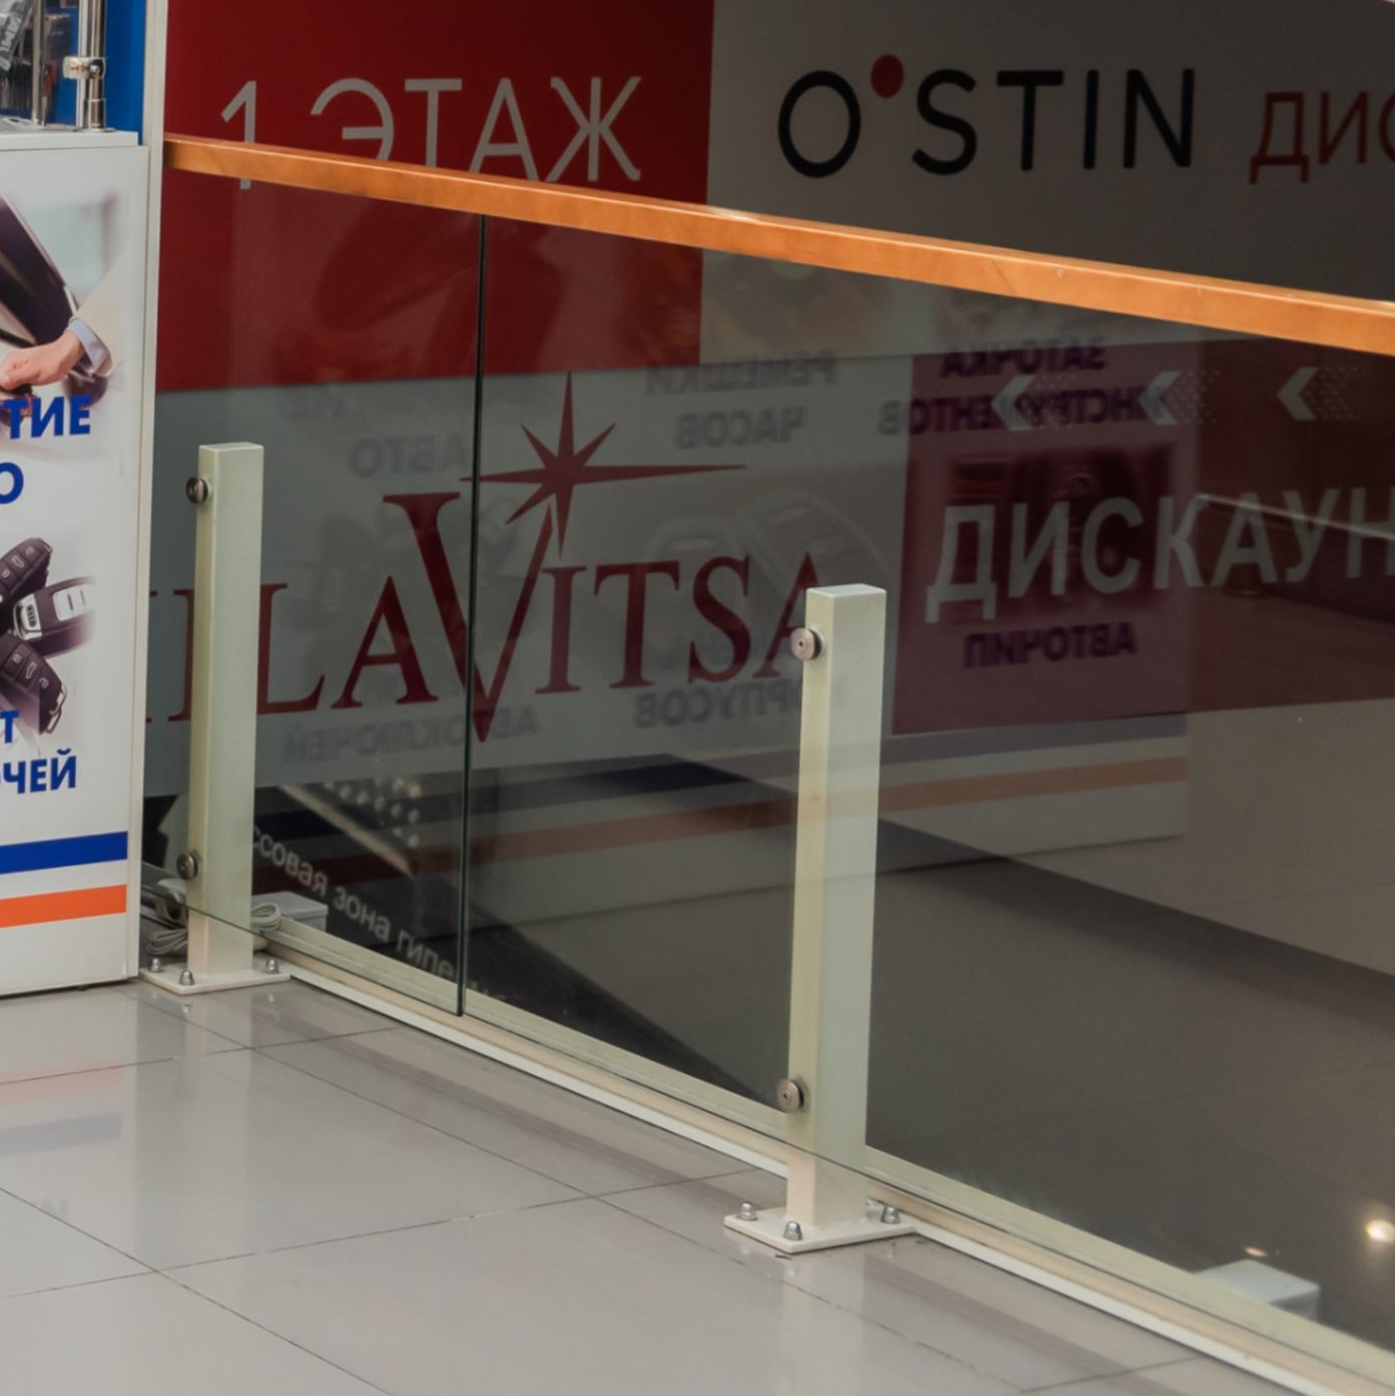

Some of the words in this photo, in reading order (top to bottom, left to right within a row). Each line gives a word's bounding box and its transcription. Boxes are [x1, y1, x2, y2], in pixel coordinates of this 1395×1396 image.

[221, 80, 257, 190] 1
[311, 76, 642, 184] ЭТАЖ
[332, 886, 391, 942] зона
